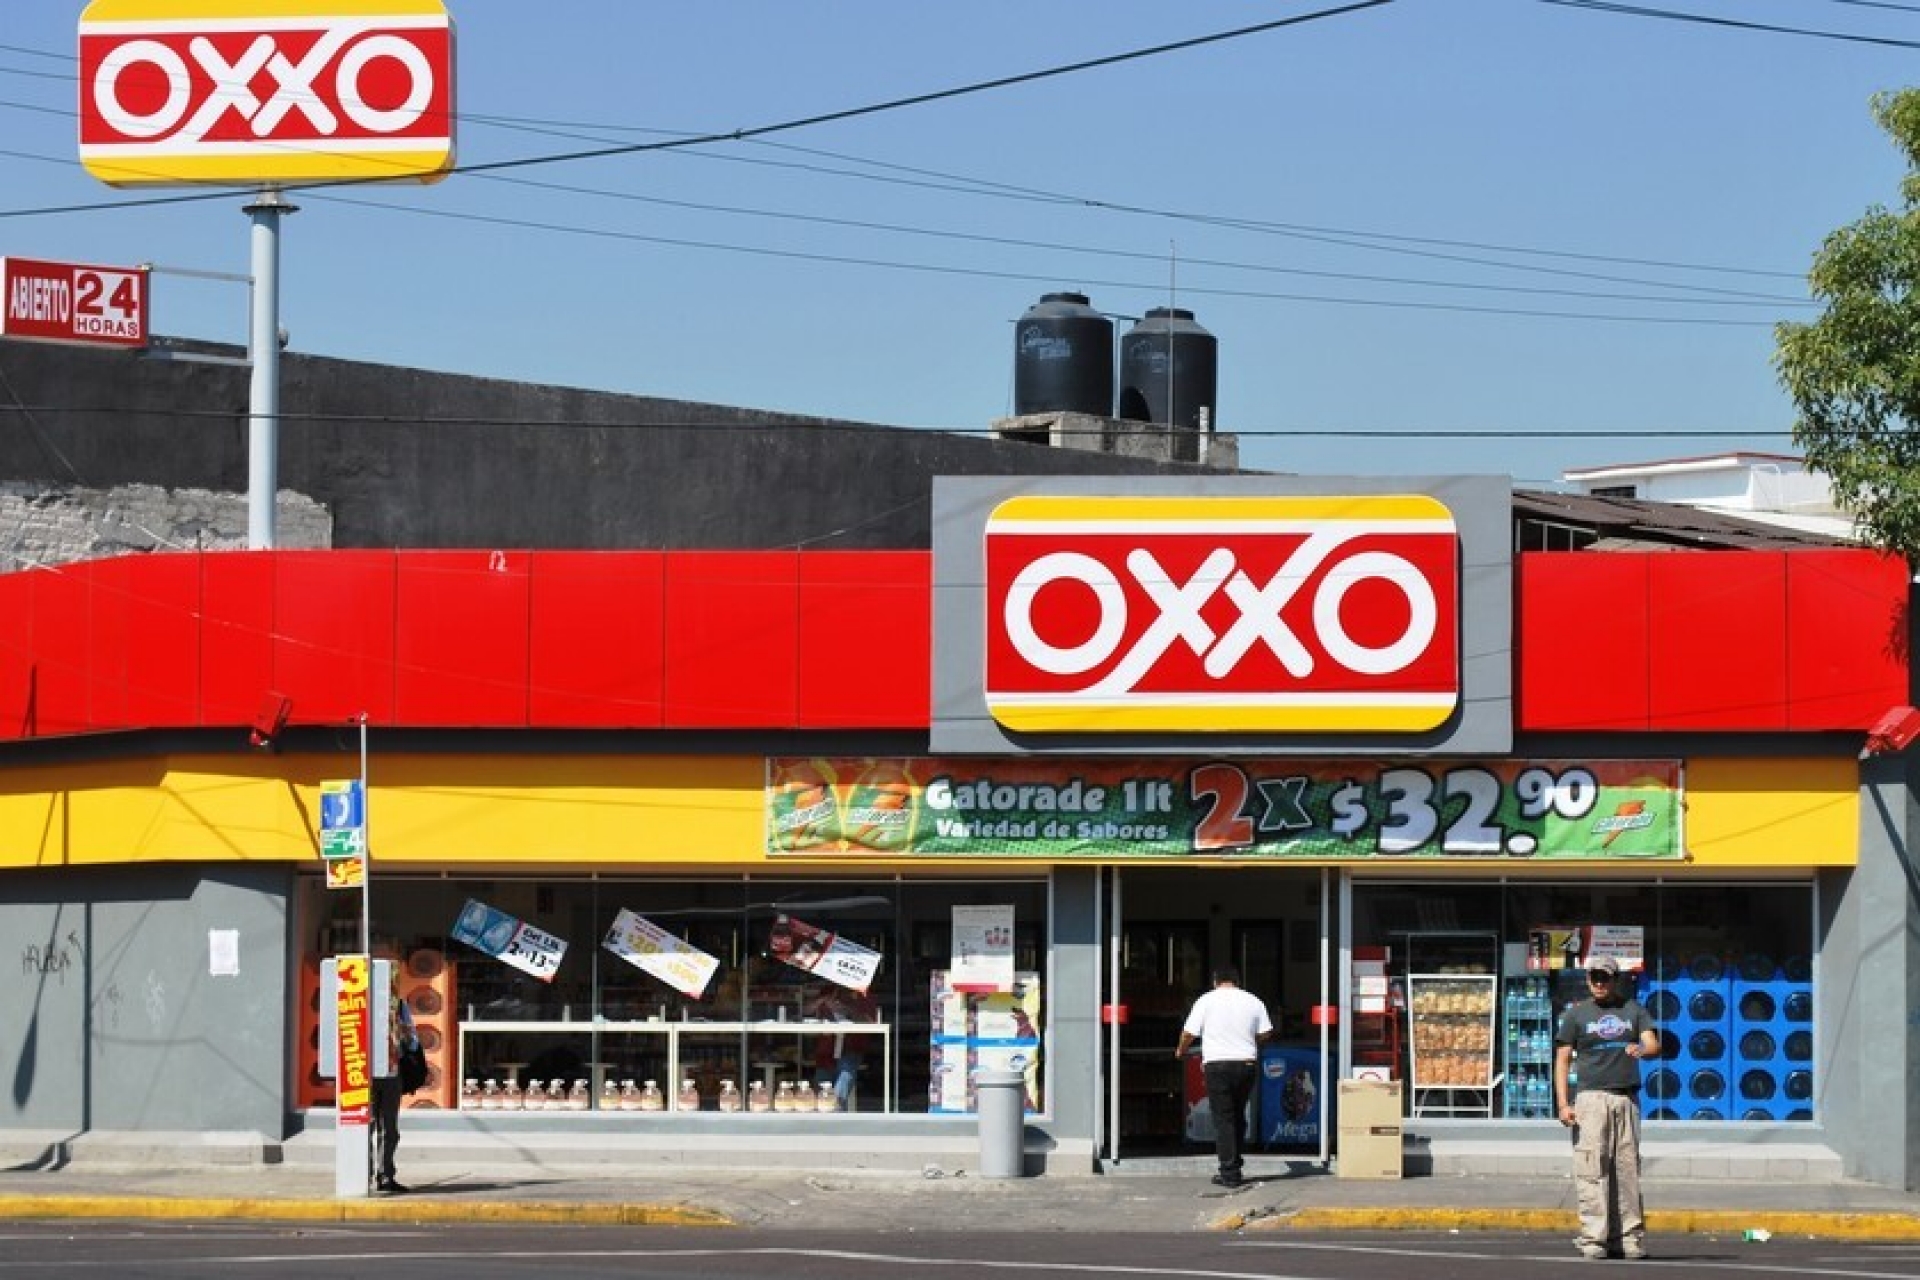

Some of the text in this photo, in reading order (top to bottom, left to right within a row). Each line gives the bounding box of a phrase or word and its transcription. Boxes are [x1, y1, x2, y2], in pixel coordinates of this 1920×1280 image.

[93, 32, 434, 139] OXXO
[9, 276, 69, 323] ABIERTO
[77, 272, 137, 318] 24
[77, 317, 138, 336] HORAS
[1004, 546, 1437, 680] OXXO
[925, 778, 1106, 812] Gatorade
[936, 817, 1169, 839] Variedad de Sabores
